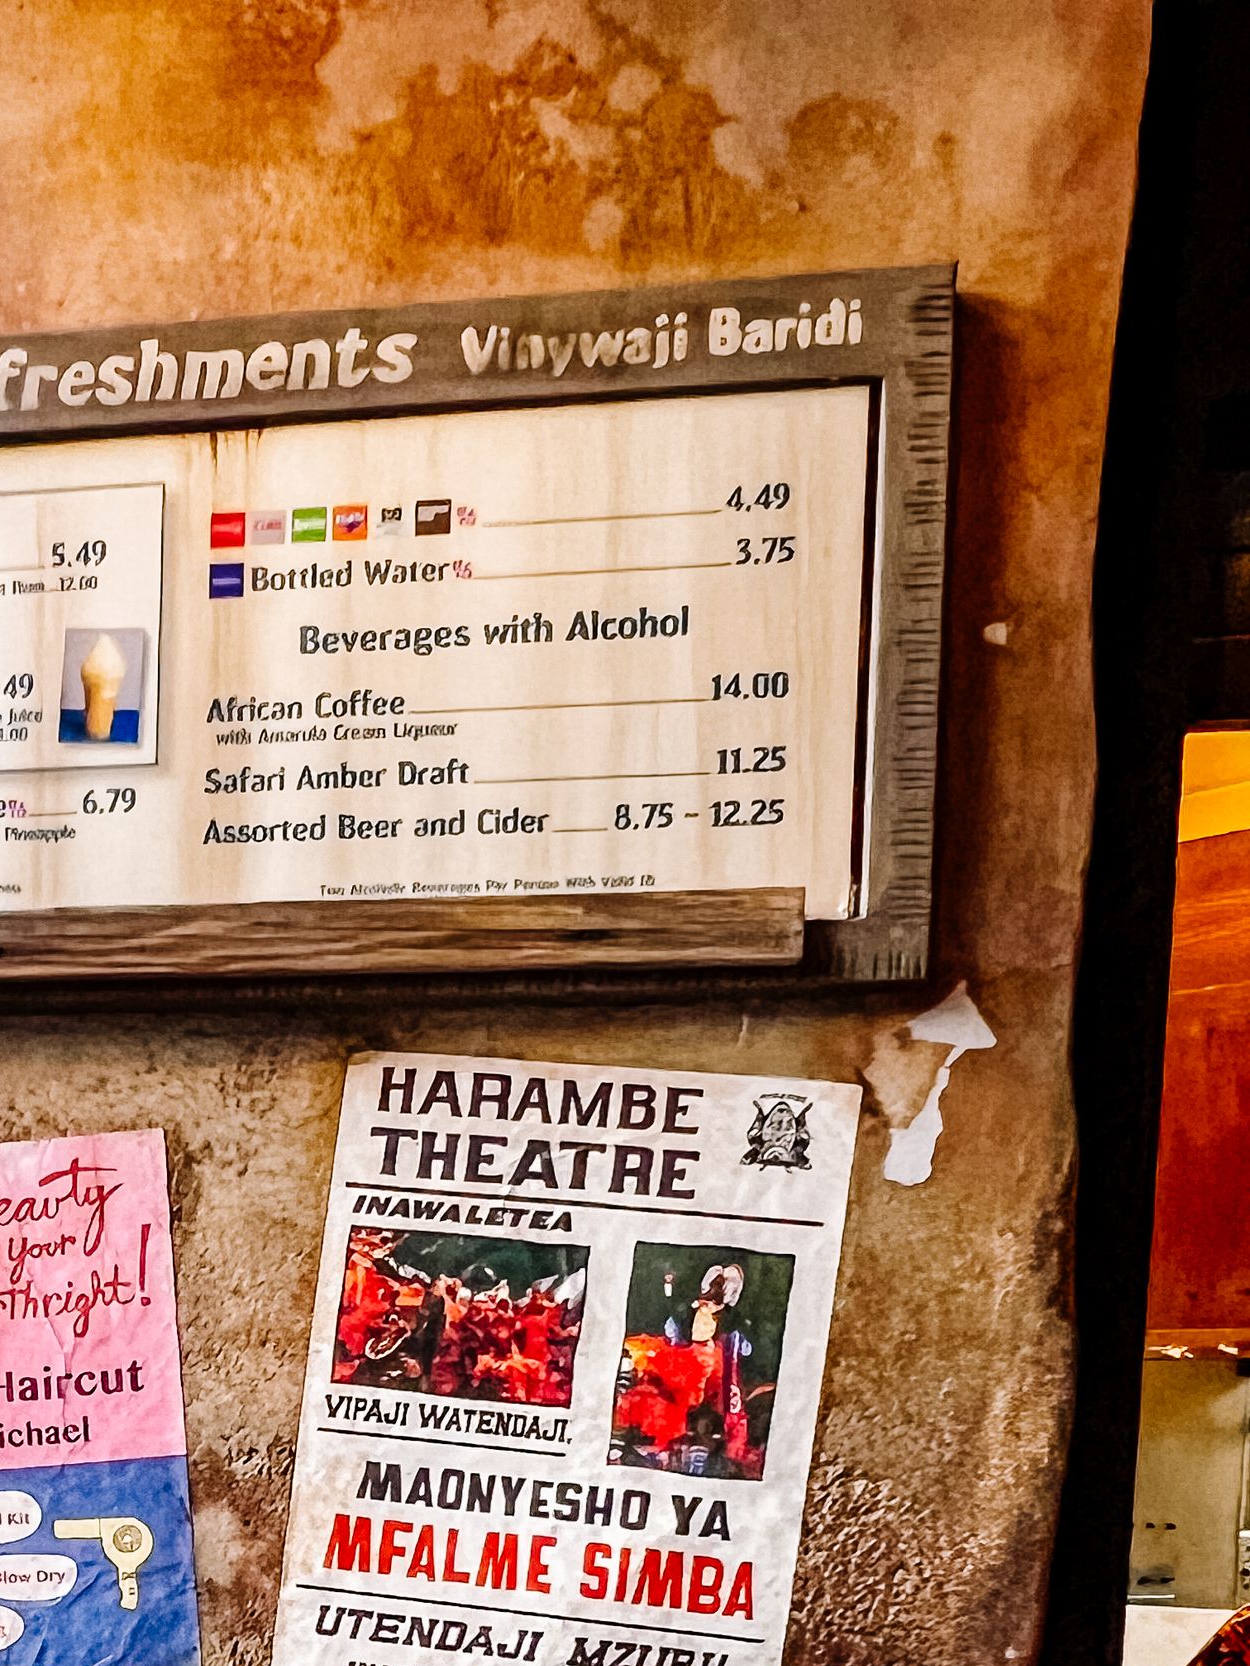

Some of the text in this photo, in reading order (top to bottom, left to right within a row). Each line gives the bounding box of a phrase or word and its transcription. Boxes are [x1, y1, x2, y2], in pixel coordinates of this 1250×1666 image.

[460, 311, 689, 378] Vinywaji
[708, 298, 862, 356] Baridi
[725, 483, 791, 513] 4.49
[51, 539, 108, 568] 5.49
[250, 536, 797, 592] Bottled Water 3.75
[299, 606, 690, 656] Beverages with Alcohol
[206, 671, 790, 724] African Coffee 14.00
[203, 746, 788, 795] Safari Amber Draft 11.25
[81, 788, 137, 815] 6.79
[203, 799, 785, 845] Assorted Beer and Cider 8.75 12.25
[377, 1066, 705, 1135] HARAMBE
[369, 1126, 701, 1200] THEATRE
[352, 1195, 573, 1233] INAWALETEA
[8, 1231, 76, 1263] your
[324, 1394, 410, 1427] VIPAJI
[7, 1511, 31, 1526] Kit
[356, 1460, 732, 1542] MAONYESHO YA
[35, 1568, 66, 1587] Dry
[323, 1513, 756, 1621] MFALME SIMBA
[314, 1604, 544, 1662] UTENDAJI
